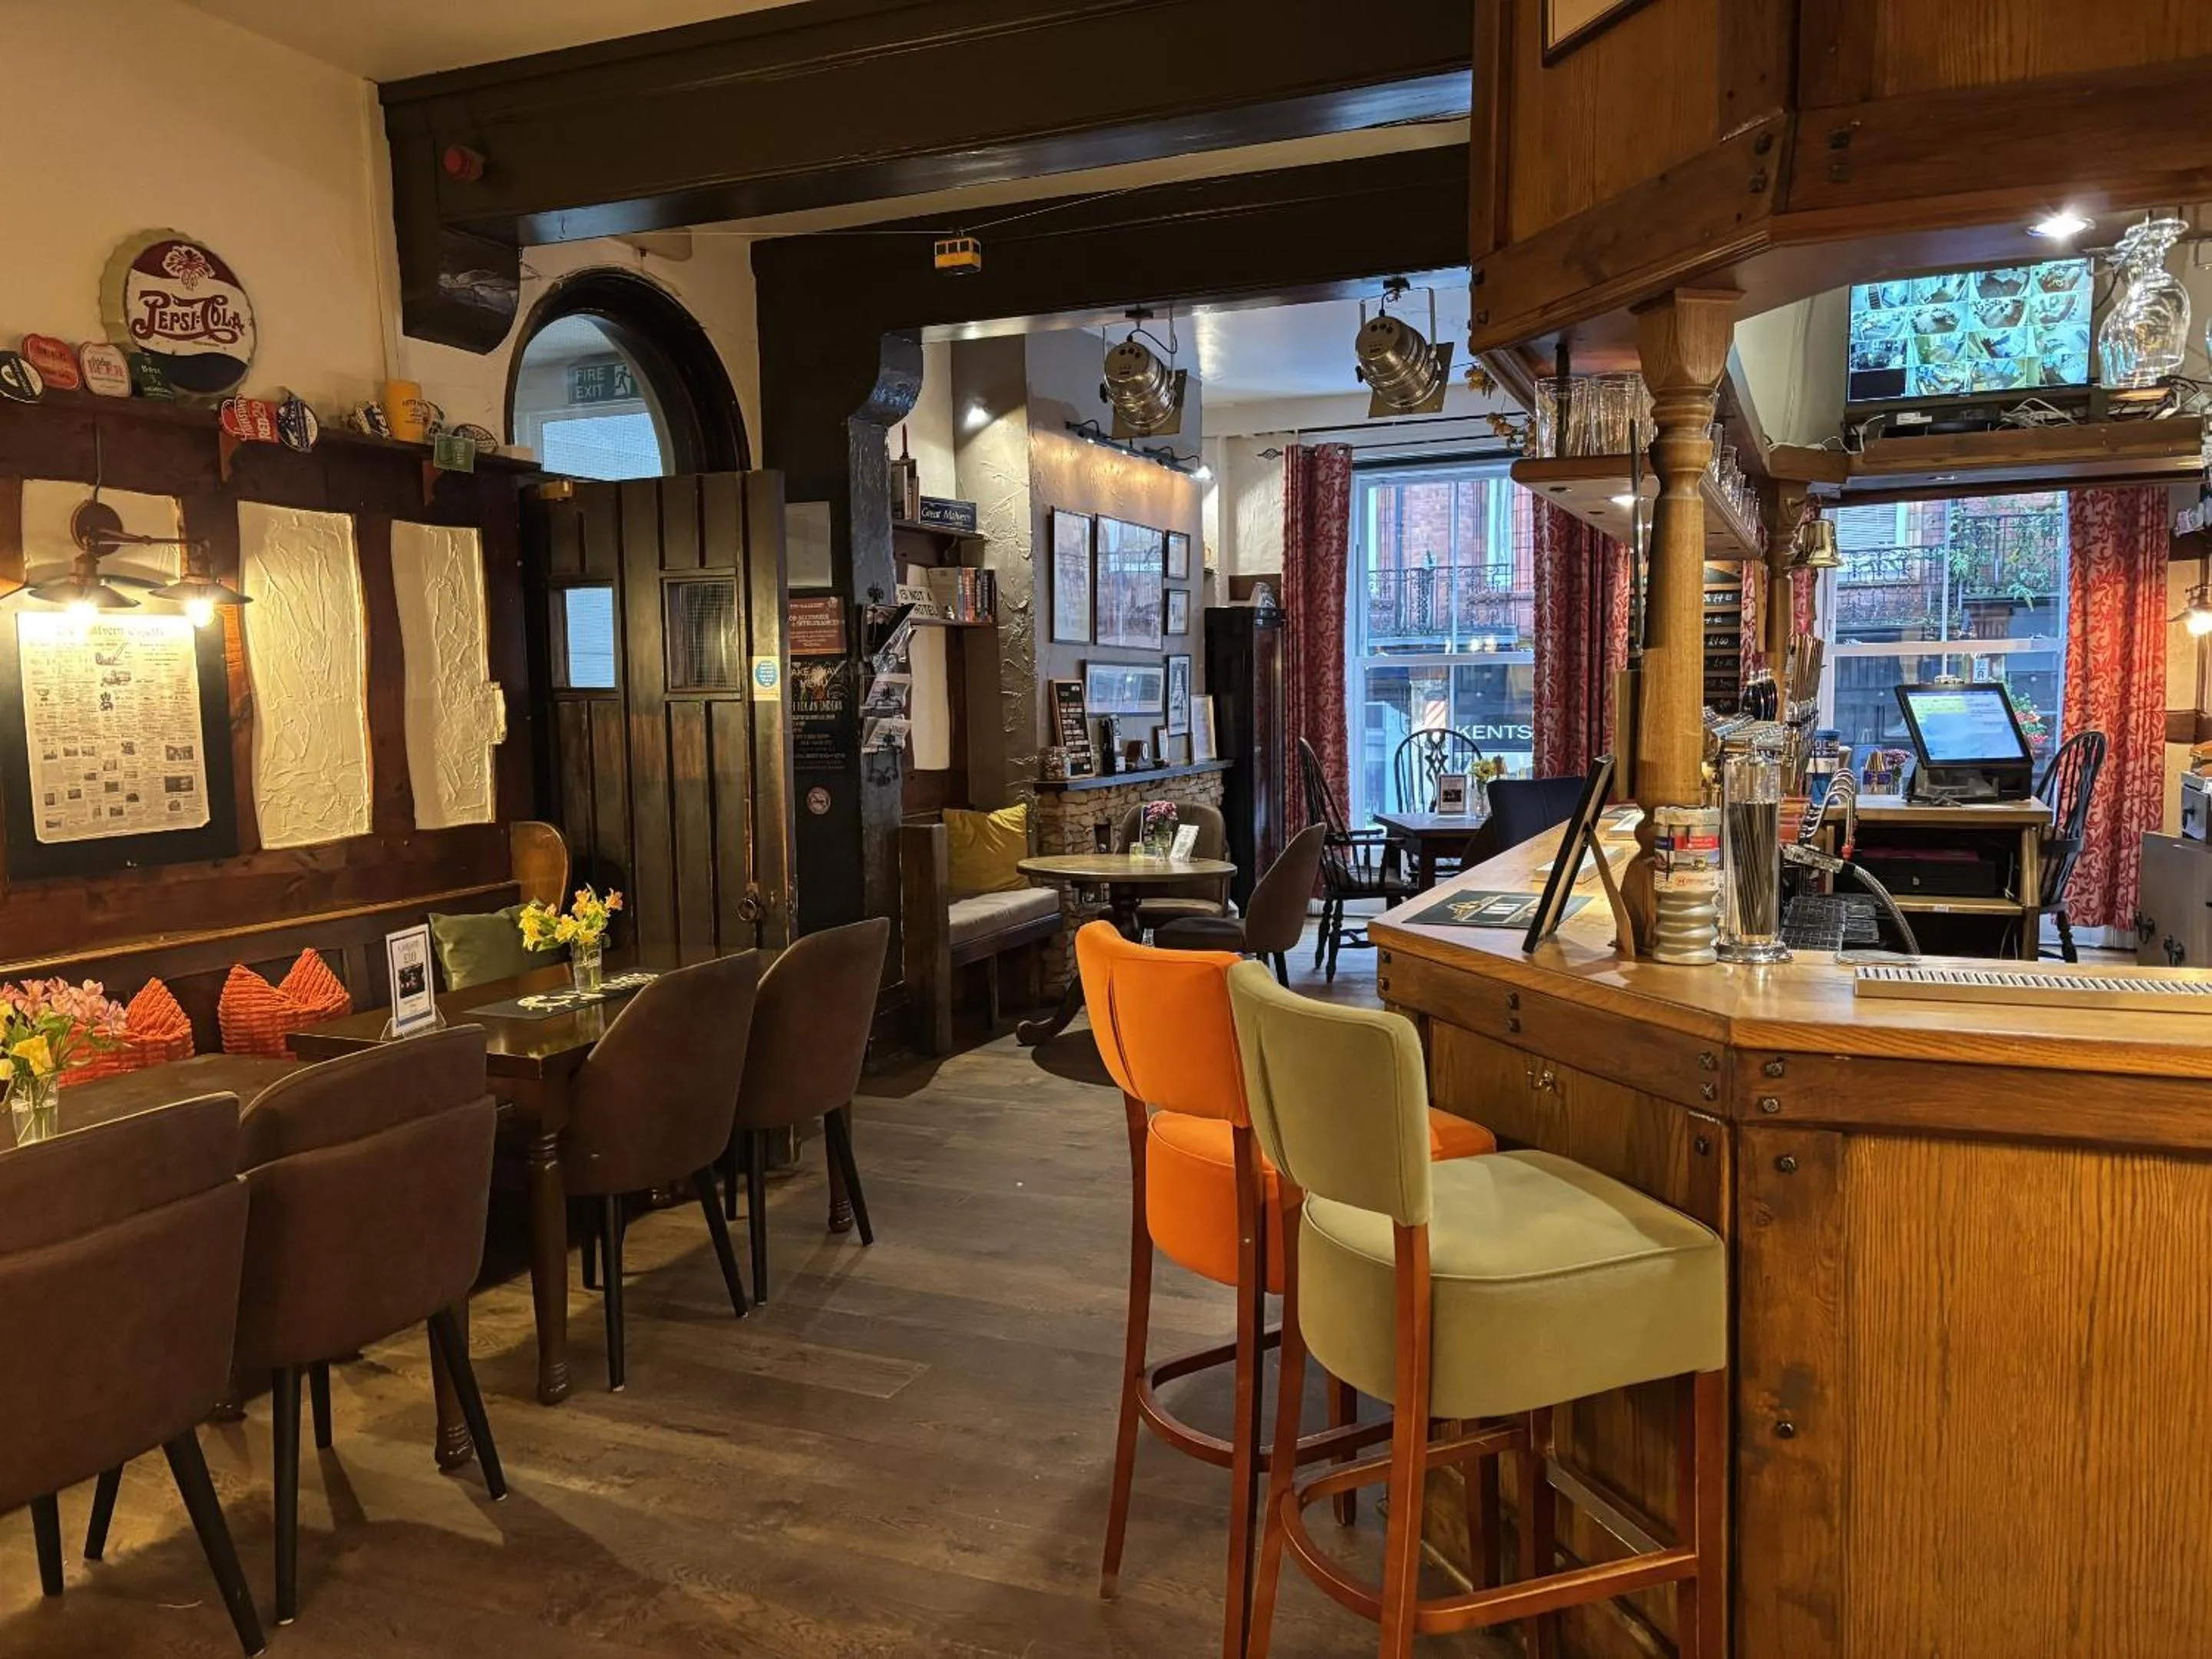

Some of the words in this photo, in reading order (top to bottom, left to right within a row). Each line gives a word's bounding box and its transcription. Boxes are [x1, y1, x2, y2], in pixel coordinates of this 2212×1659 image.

[576, 367, 604, 382] FIRE
[577, 385, 602, 398] EXIT
[943, 508, 973, 524] Malvern
[909, 589, 924, 601] NOT
[1455, 725, 1533, 740] KENTS
